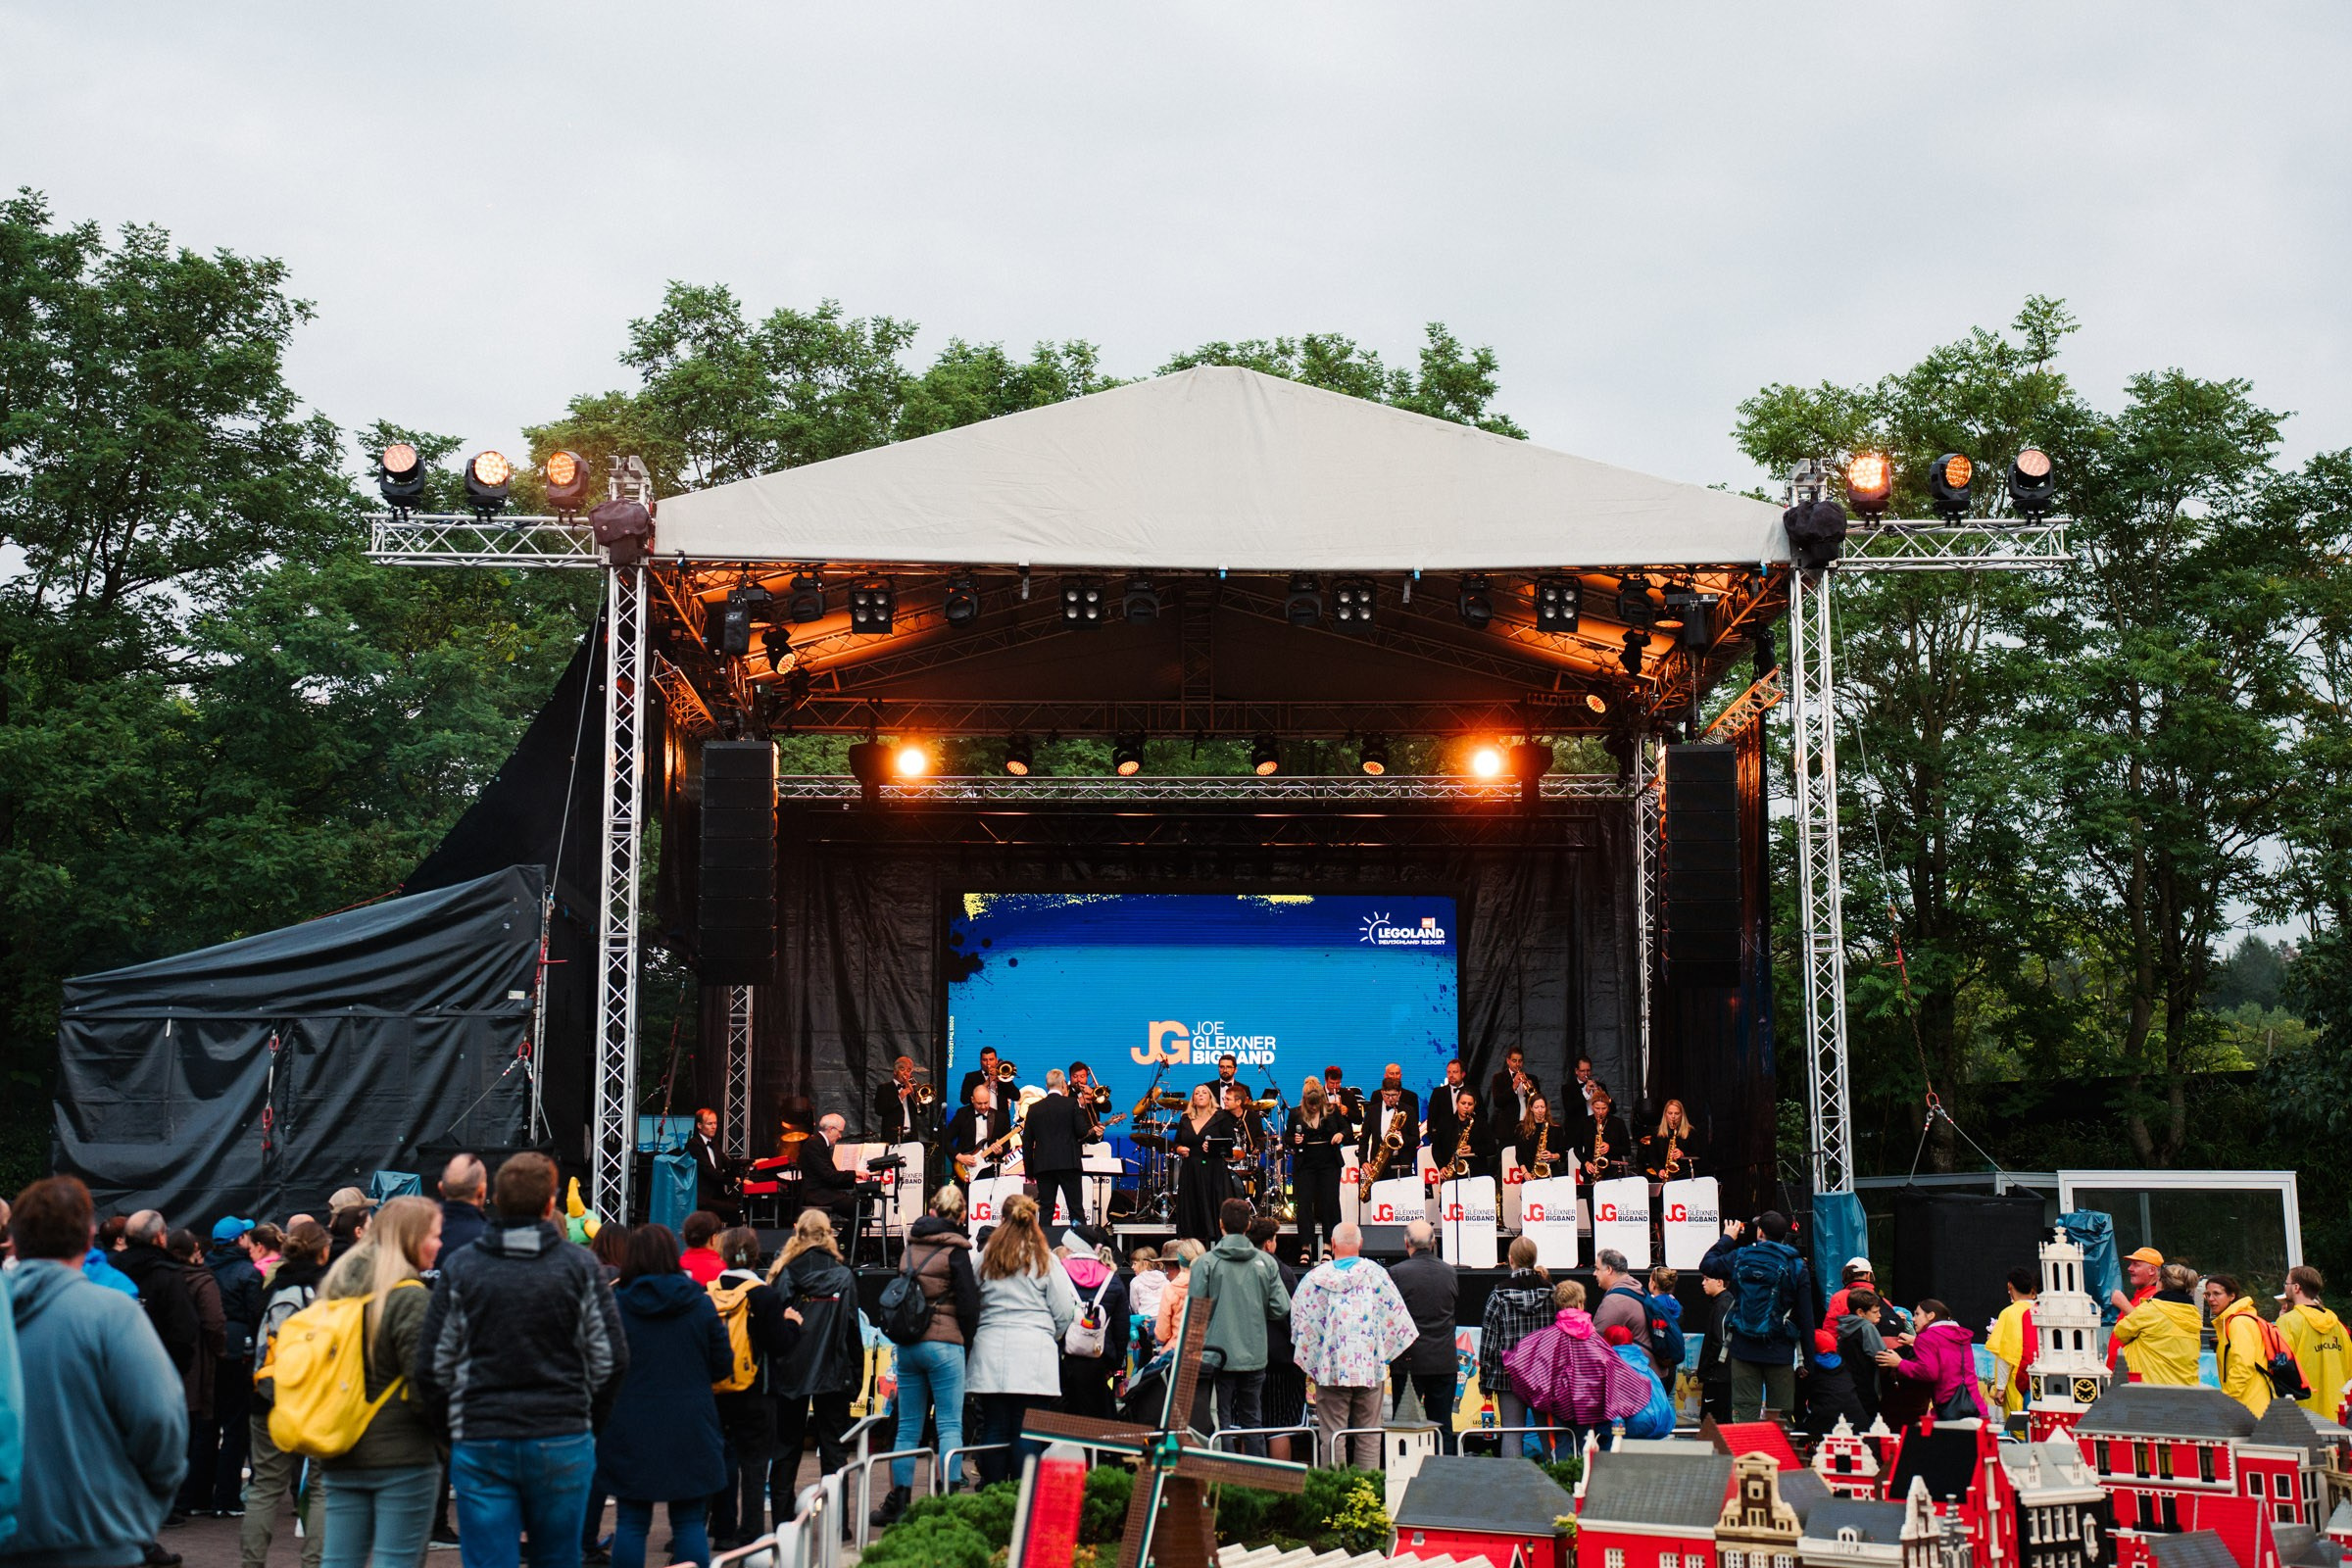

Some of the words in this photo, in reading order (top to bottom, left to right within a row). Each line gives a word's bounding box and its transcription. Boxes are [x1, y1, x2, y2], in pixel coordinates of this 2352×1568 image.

[1378, 918, 1446, 939] LEGOLAND
[1192, 1021, 1225, 1036] JOE
[1130, 1020, 1191, 1065] JG
[1192, 1036, 1276, 1051] GLEIXNER
[1503, 1167, 1523, 1184] JG
[970, 1202, 991, 1221] JG
[1373, 1203, 1394, 1222] JG
[1443, 1203, 1464, 1221] JG
[1523, 1203, 1544, 1222] JG
[1595, 1203, 1617, 1222] JG
[1665, 1203, 1687, 1222] JG
